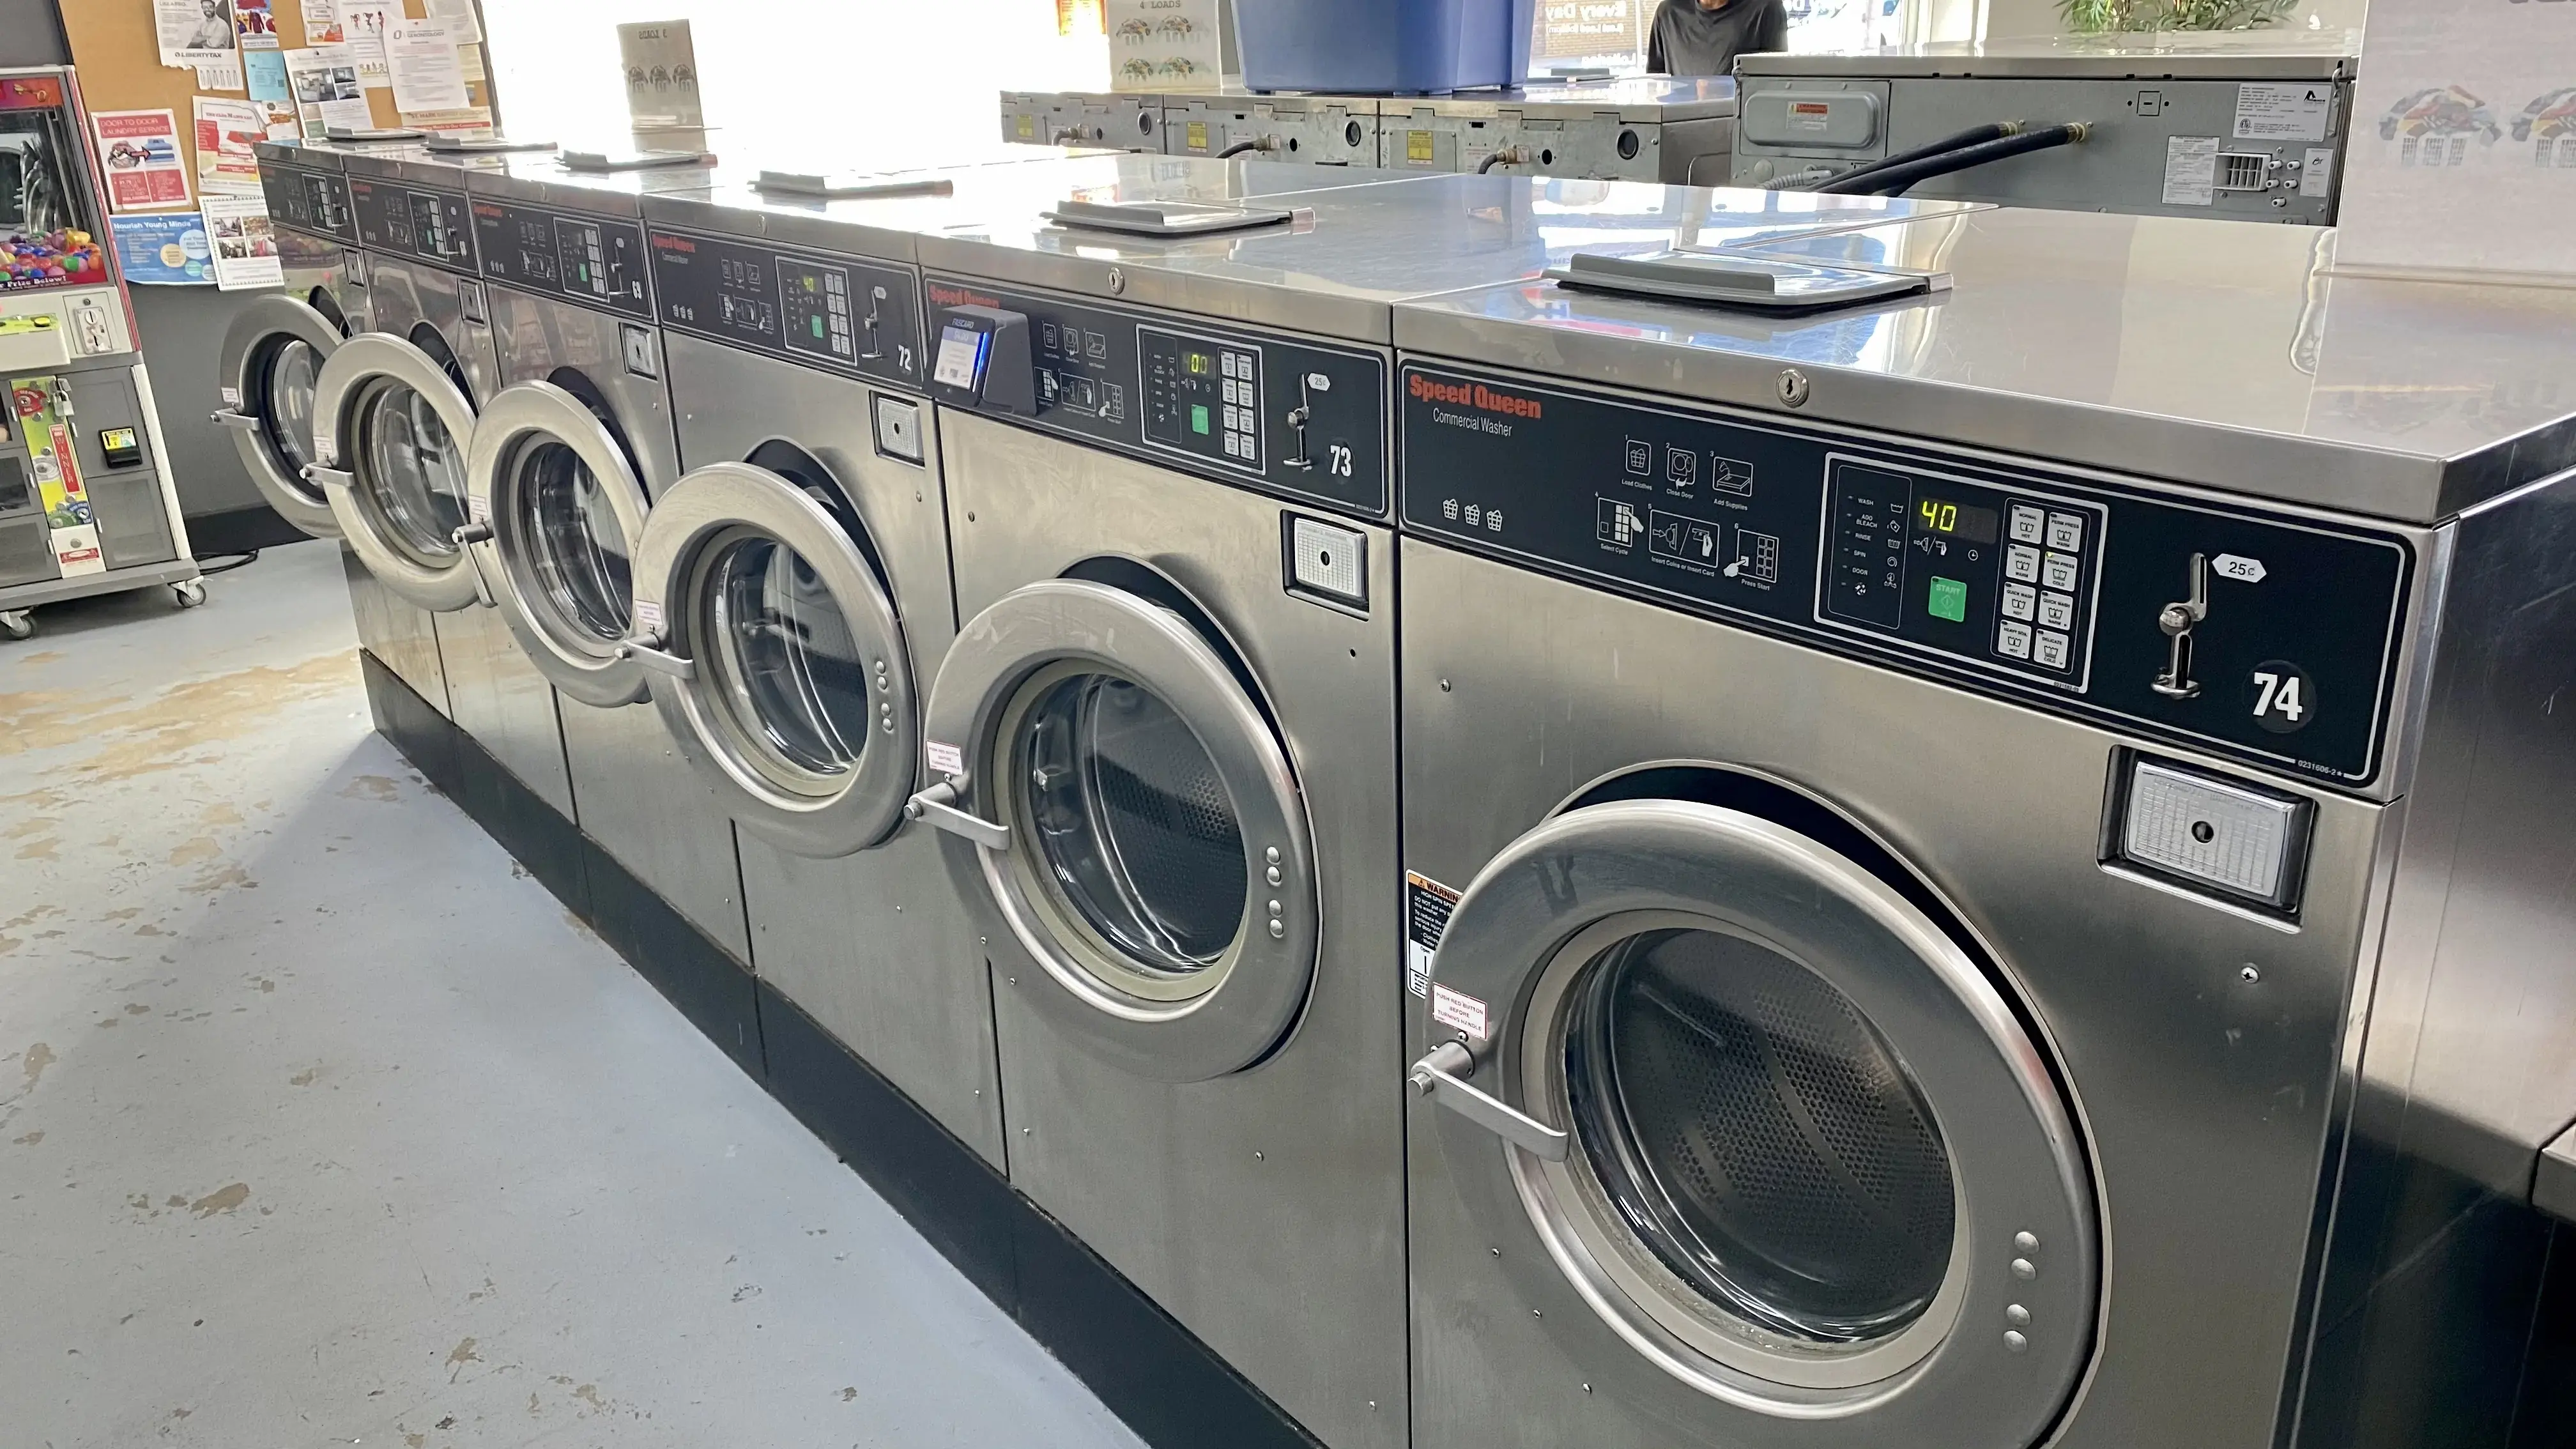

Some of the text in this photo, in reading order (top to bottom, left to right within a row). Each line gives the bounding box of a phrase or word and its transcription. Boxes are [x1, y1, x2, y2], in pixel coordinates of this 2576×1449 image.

[1140, 0, 1181, 9] 4 LOADS
[100, 118, 122, 126] DOOR
[102, 125, 169, 135] LAUNDRY SERVICE
[144, 221, 167, 230] Young
[652, 234, 673, 249] Speed
[34, 275, 66, 284] Below!
[930, 284, 1000, 308] Speed Queen
[898, 344, 912, 372] 72
[1410, 373, 1541, 419] Speed Queen
[1433, 407, 1512, 438] Commercial Washer
[1330, 445, 1351, 477] 73
[1621, 479, 1652, 491] Load Clothes
[1666, 488, 1680, 497] Close
[1726, 500, 1748, 511] Supplies
[1922, 501, 1957, 532] 40
[1856, 519, 1878, 528] BLEACH
[1855, 533, 1871, 541] RINSE
[1600, 543, 1629, 555] Select Cycle
[1652, 556, 1666, 565] Insert
[1666, 560, 1680, 569] Coins
[1687, 565, 1701, 574] Insert
[1702, 568, 1715, 577] Card
[1852, 567, 1868, 576] DOOR
[2228, 560, 2256, 577] 25¢
[1741, 578, 1770, 590] Press Start
[1936, 584, 1961, 595] START
[2042, 637, 2062, 645] DELICATE
[2253, 672, 2303, 721] 74
[1421, 890, 1432, 899] HIGH
[1432, 895, 1443, 904] SPIN
[1420, 911, 1434, 923] reduce
[1414, 916, 1442, 933] serious injury
[1436, 992, 1483, 1015] PUSH RED BUTTON
[1449, 1006, 1470, 1018] BEFORE
[1438, 1009, 1482, 1031] TURNING HANDLE
